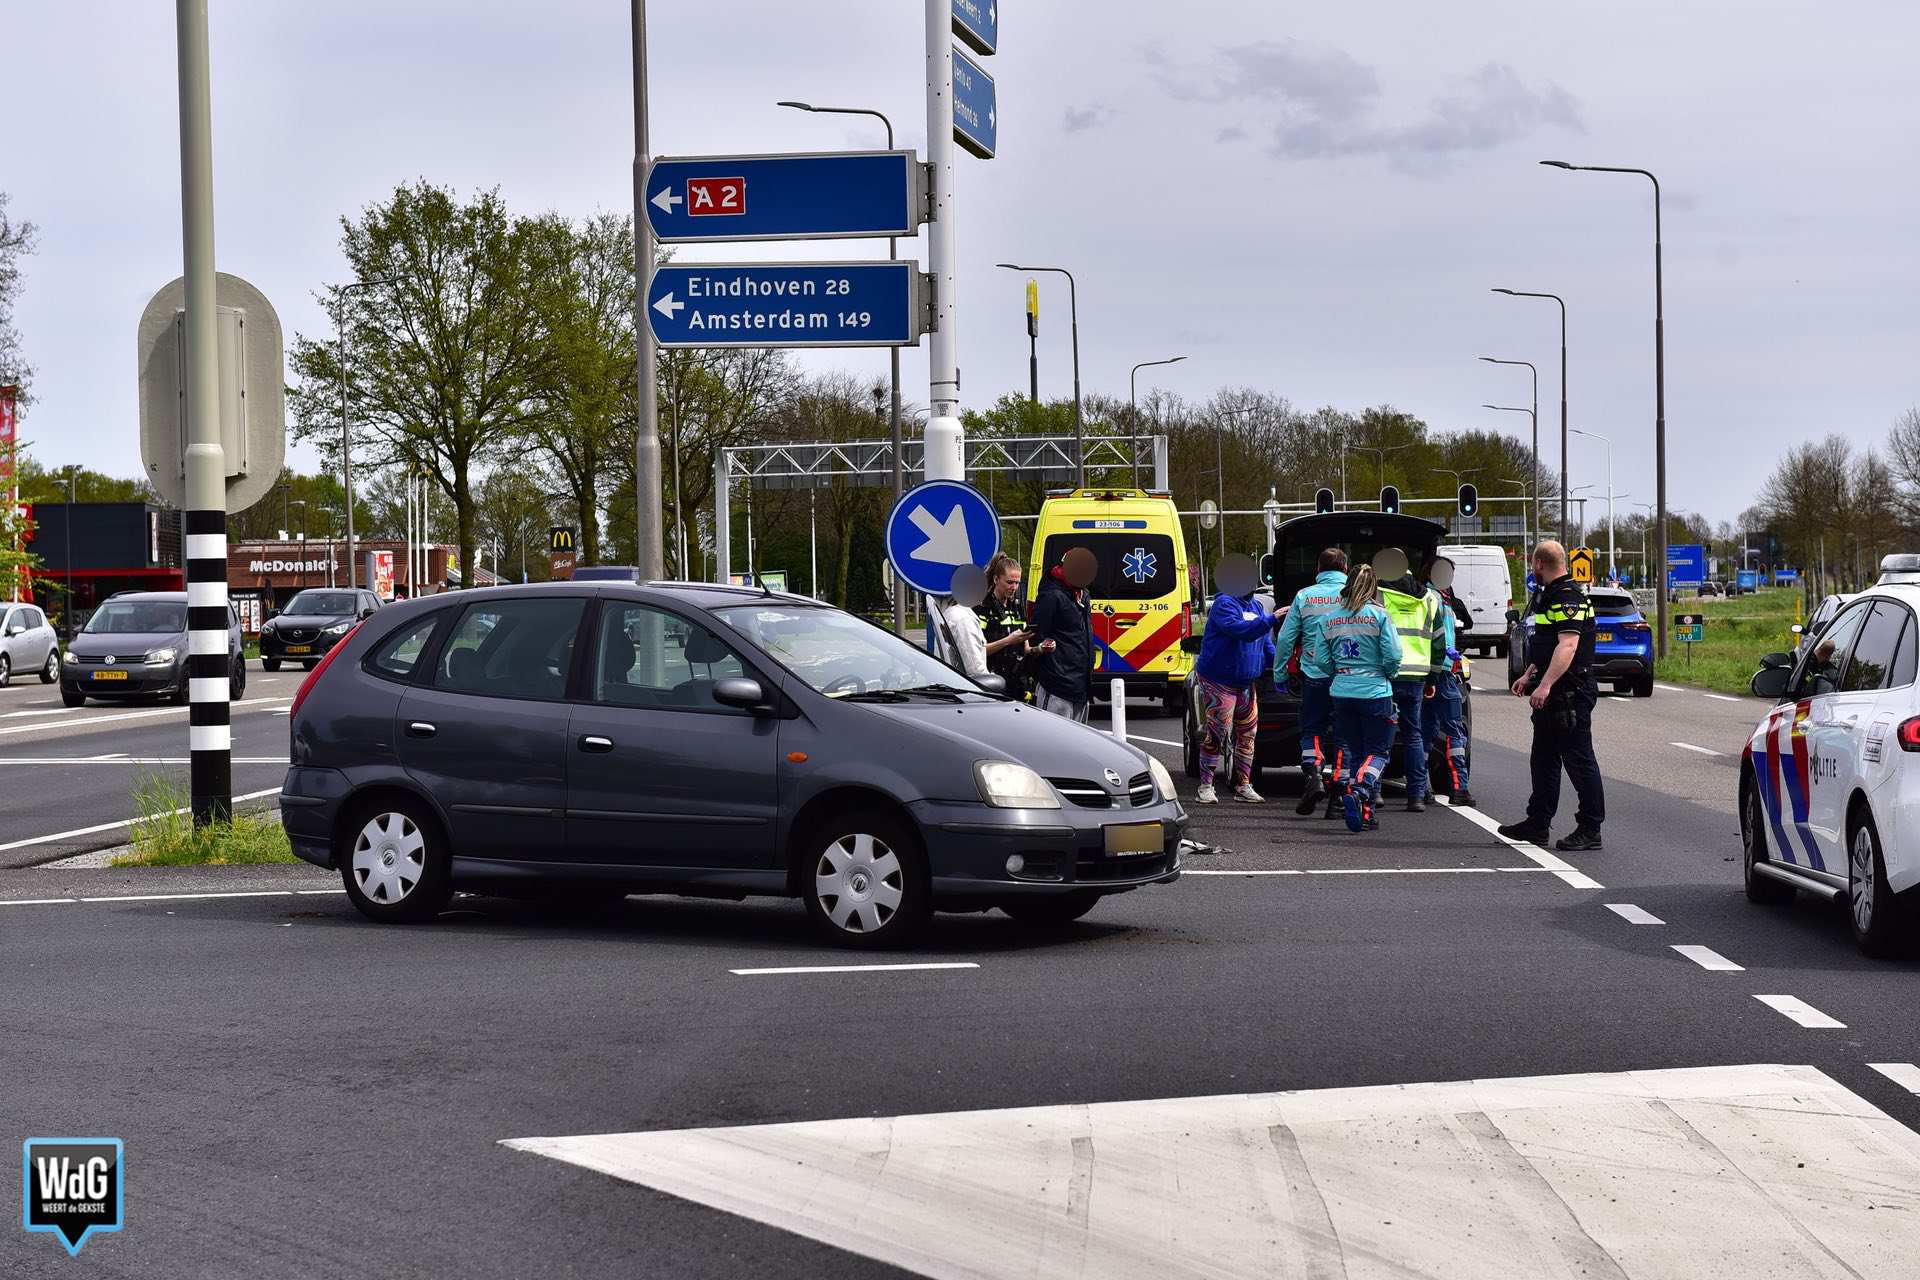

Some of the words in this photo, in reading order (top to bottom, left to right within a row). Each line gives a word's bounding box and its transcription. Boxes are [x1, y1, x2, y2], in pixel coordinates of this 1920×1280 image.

[694, 186, 714, 208] A
[721, 185, 738, 208] 2
[688, 277, 816, 297] Eindhoven
[825, 279, 850, 295] 28
[688, 310, 828, 330] Amsterdam
[838, 312, 871, 328] 149
[249, 560, 339, 573] McDonald's
[1576, 567, 1586, 577] N
[1138, 603, 1169, 611] 23-106
[1305, 596, 1341, 605] AMBULA
